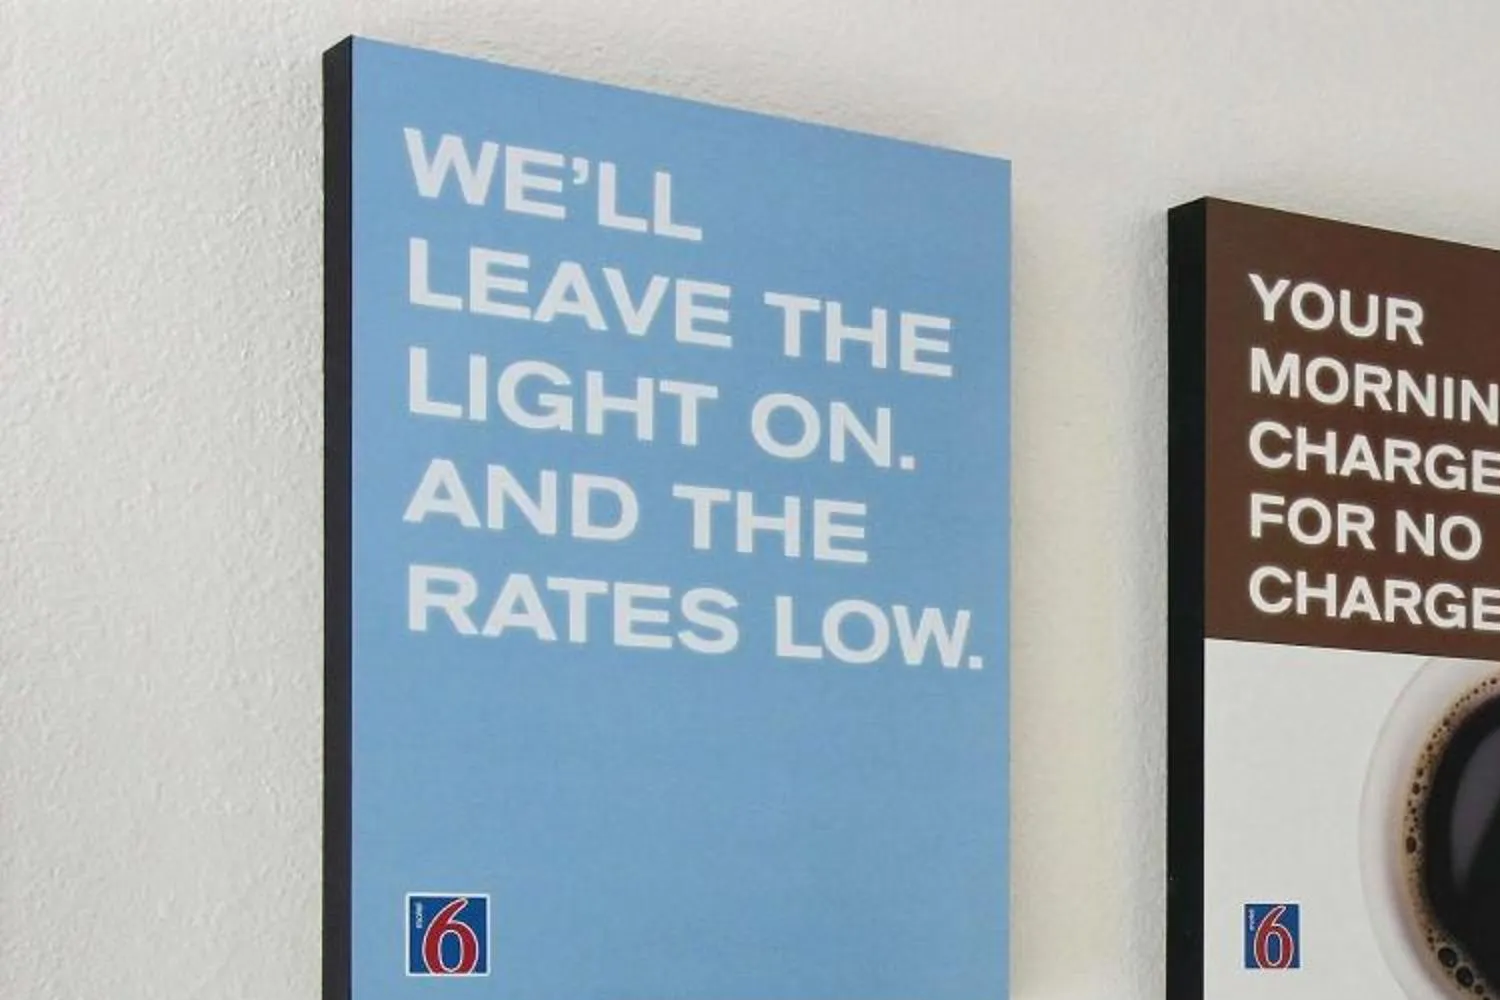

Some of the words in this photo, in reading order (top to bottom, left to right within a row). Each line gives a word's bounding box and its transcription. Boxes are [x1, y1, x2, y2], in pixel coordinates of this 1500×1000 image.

[404, 128, 702, 241] WE’LL
[409, 238, 732, 348] LEAVE
[764, 292, 952, 377] THE
[1248, 273, 1425, 346] YOUR
[409, 346, 719, 446] LIGHT
[750, 393, 915, 470] ON.
[403, 458, 640, 541] AND
[672, 484, 868, 563] THE
[1250, 492, 1376, 551] FOR
[1395, 509, 1483, 562] NO
[408, 564, 739, 654] RATES
[775, 595, 983, 670] LOW.
[422, 897, 479, 976] 6
[1253, 905, 1295, 970] 6
